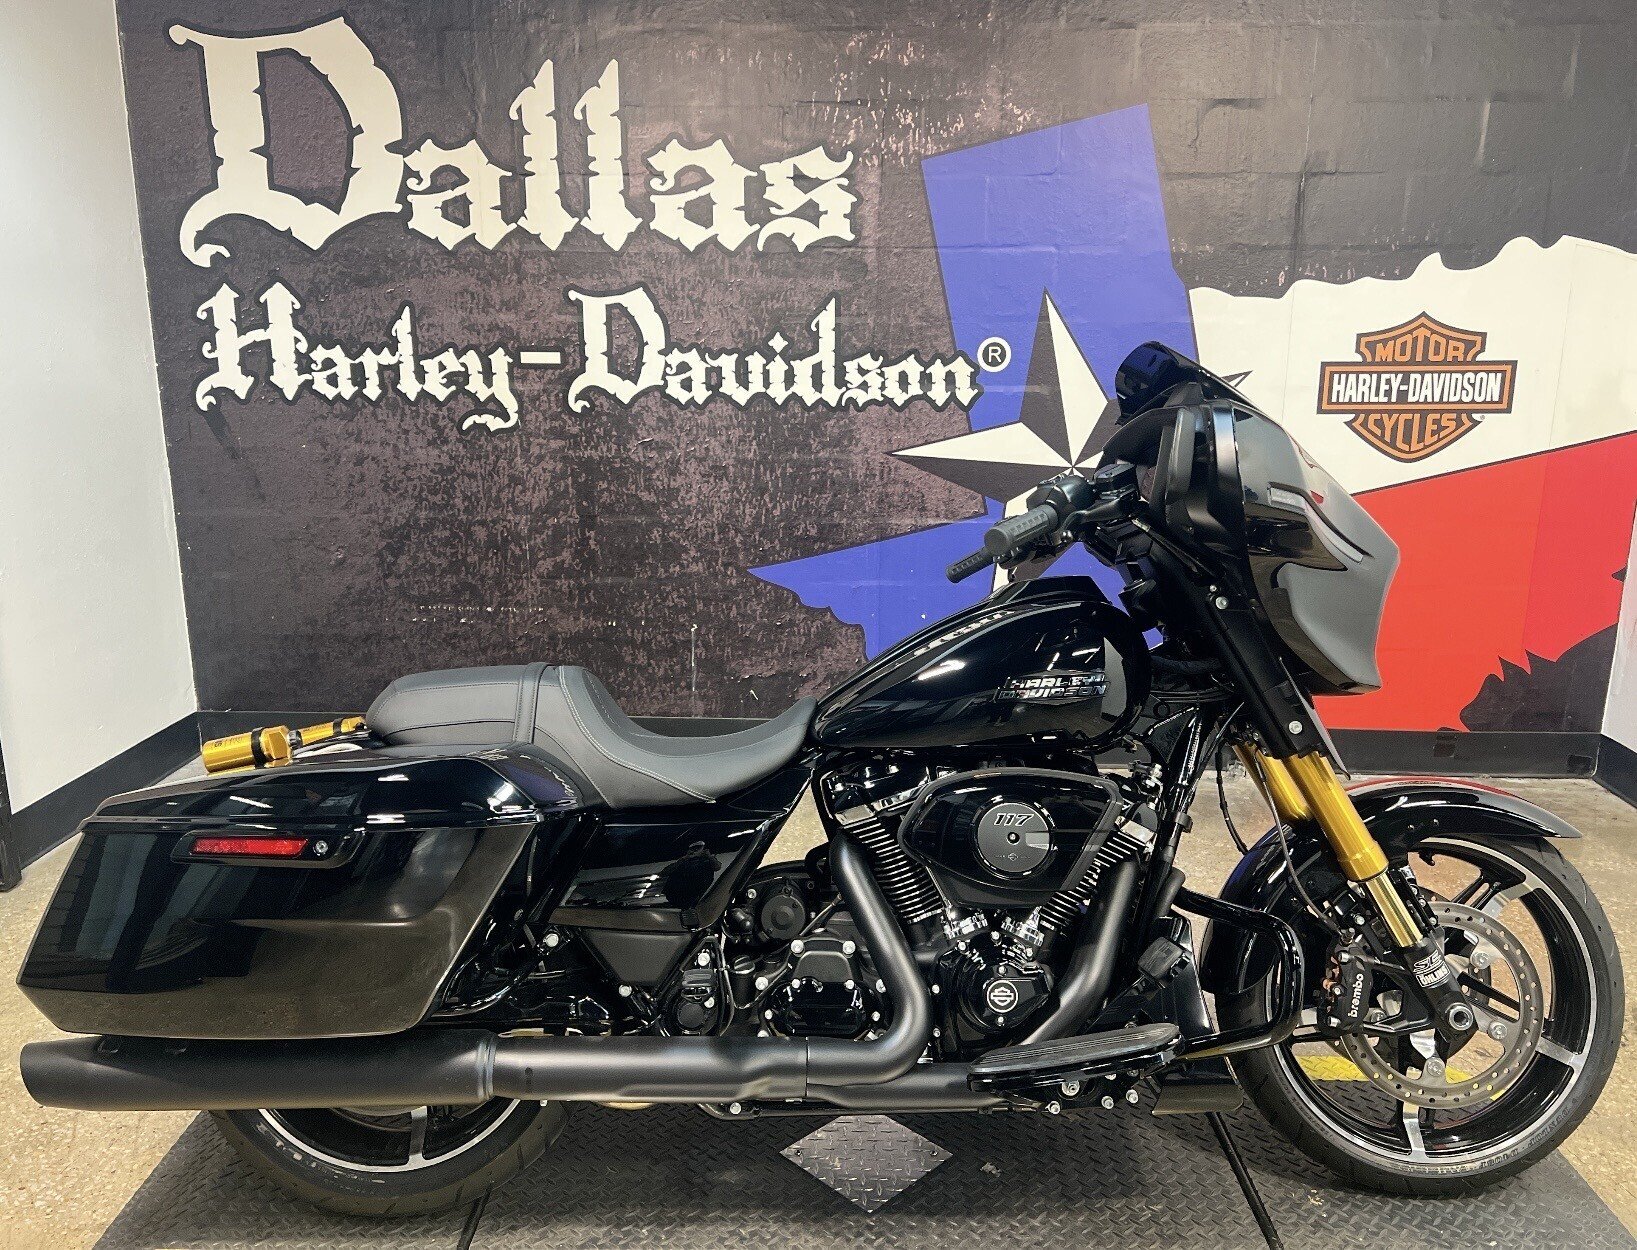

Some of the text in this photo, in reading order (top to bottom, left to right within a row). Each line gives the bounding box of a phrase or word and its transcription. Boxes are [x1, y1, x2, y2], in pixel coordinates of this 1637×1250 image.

[168, 16, 859, 266] Dallas
[196, 282, 979, 430] Harley-Davidson
[1375, 327, 1466, 362] MOTOR
[1331, 372, 1502, 403] HARLEY-DAVIDSON
[1367, 413, 1457, 452] CYCLES
[998, 685, 1106, 699] DAVIDSON
[1009, 675, 1105, 689] HARLEY
[994, 813, 1034, 827] 117
[1347, 973, 1364, 1018] brembo
